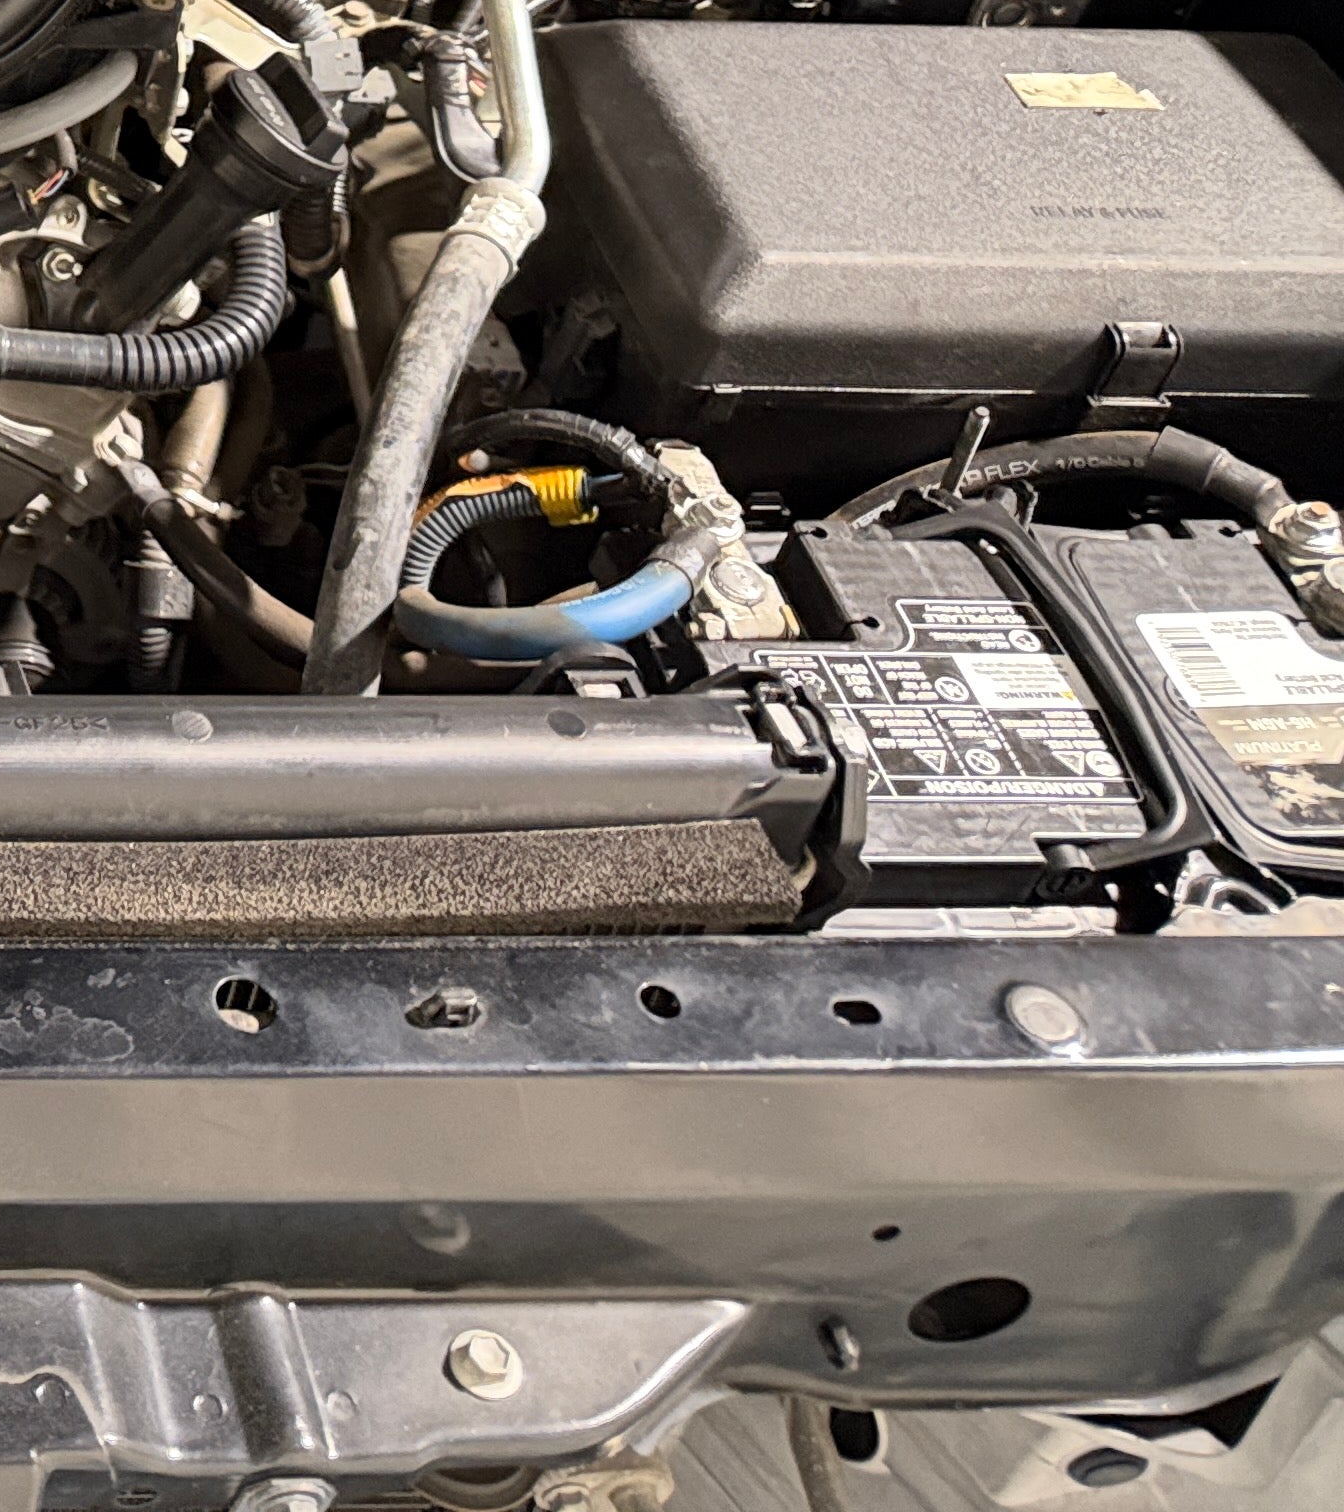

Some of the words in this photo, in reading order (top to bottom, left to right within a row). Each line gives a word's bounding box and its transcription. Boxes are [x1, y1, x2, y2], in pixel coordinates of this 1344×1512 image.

[985, 458, 1041, 483] FLEX
[1236, 742, 1323, 755] PLATINUM
[922, 780, 1090, 794] DANGER/POISON
